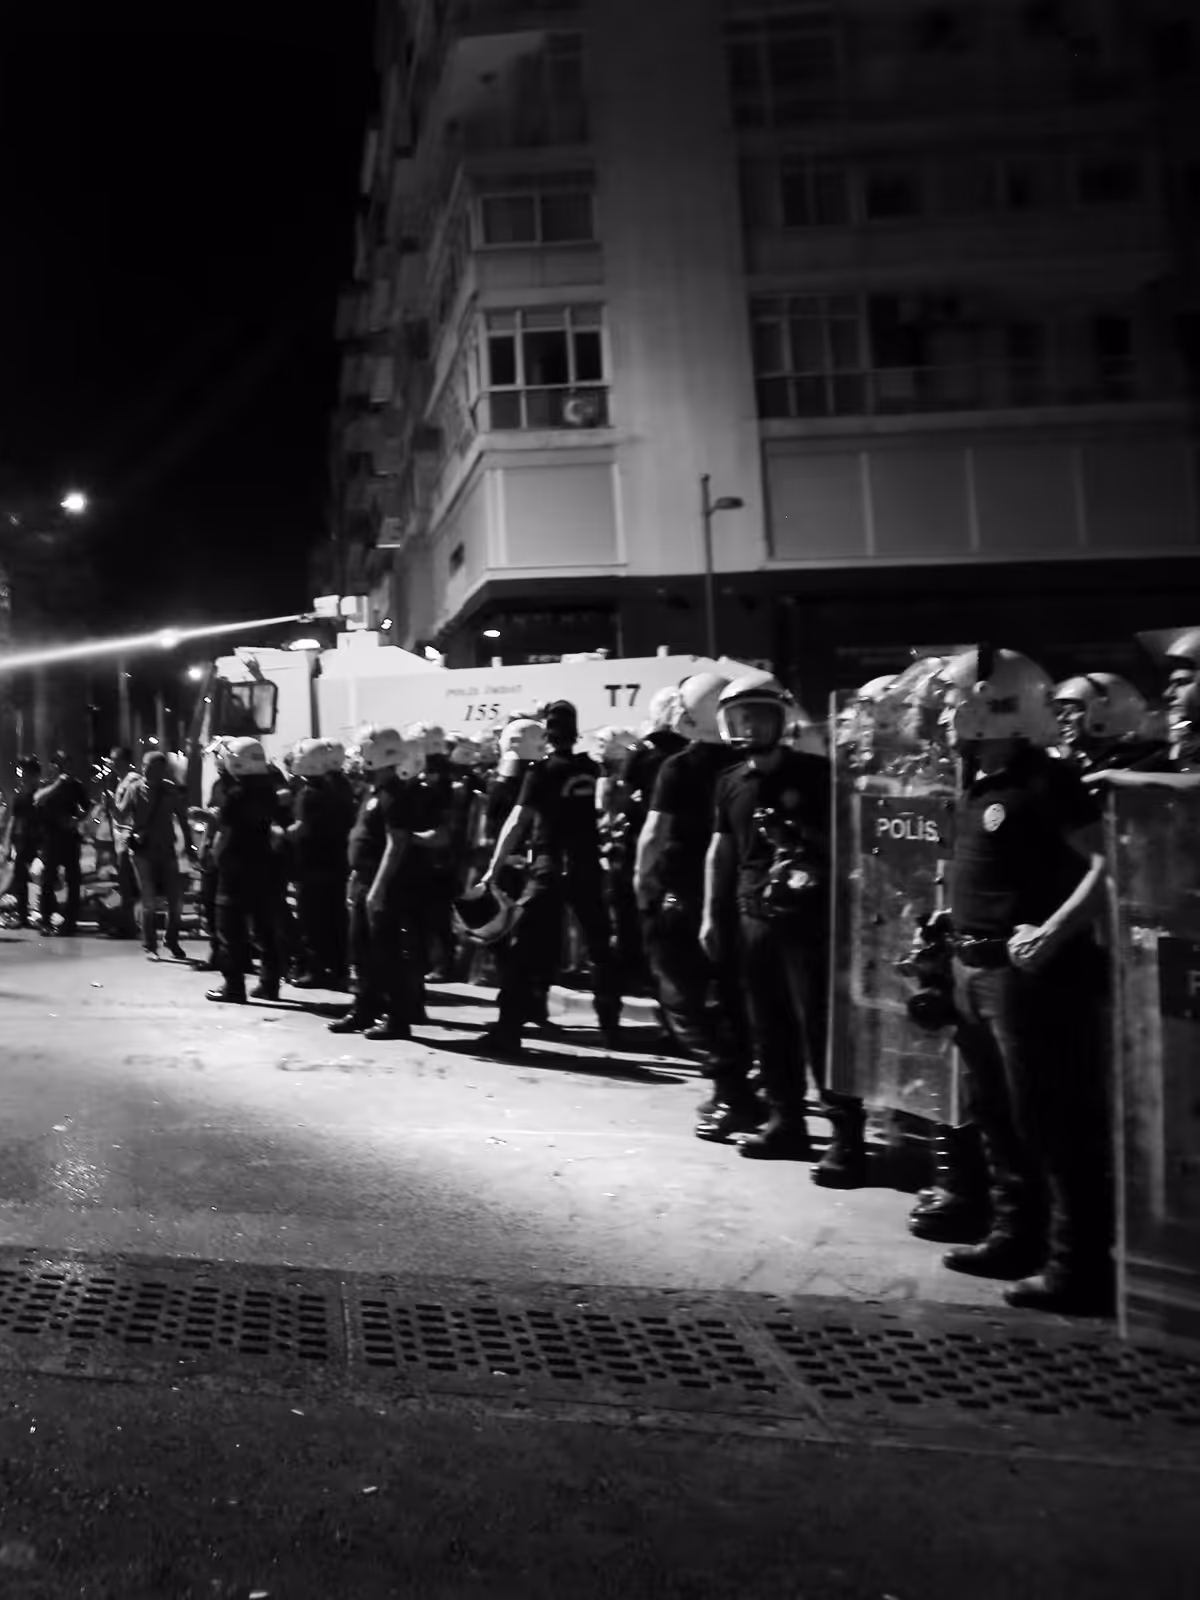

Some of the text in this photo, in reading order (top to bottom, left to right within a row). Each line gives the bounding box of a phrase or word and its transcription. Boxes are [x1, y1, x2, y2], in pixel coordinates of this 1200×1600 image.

[605, 684, 641, 707] T7
[463, 703, 501, 721] 155
[875, 815, 940, 842] POLİS
